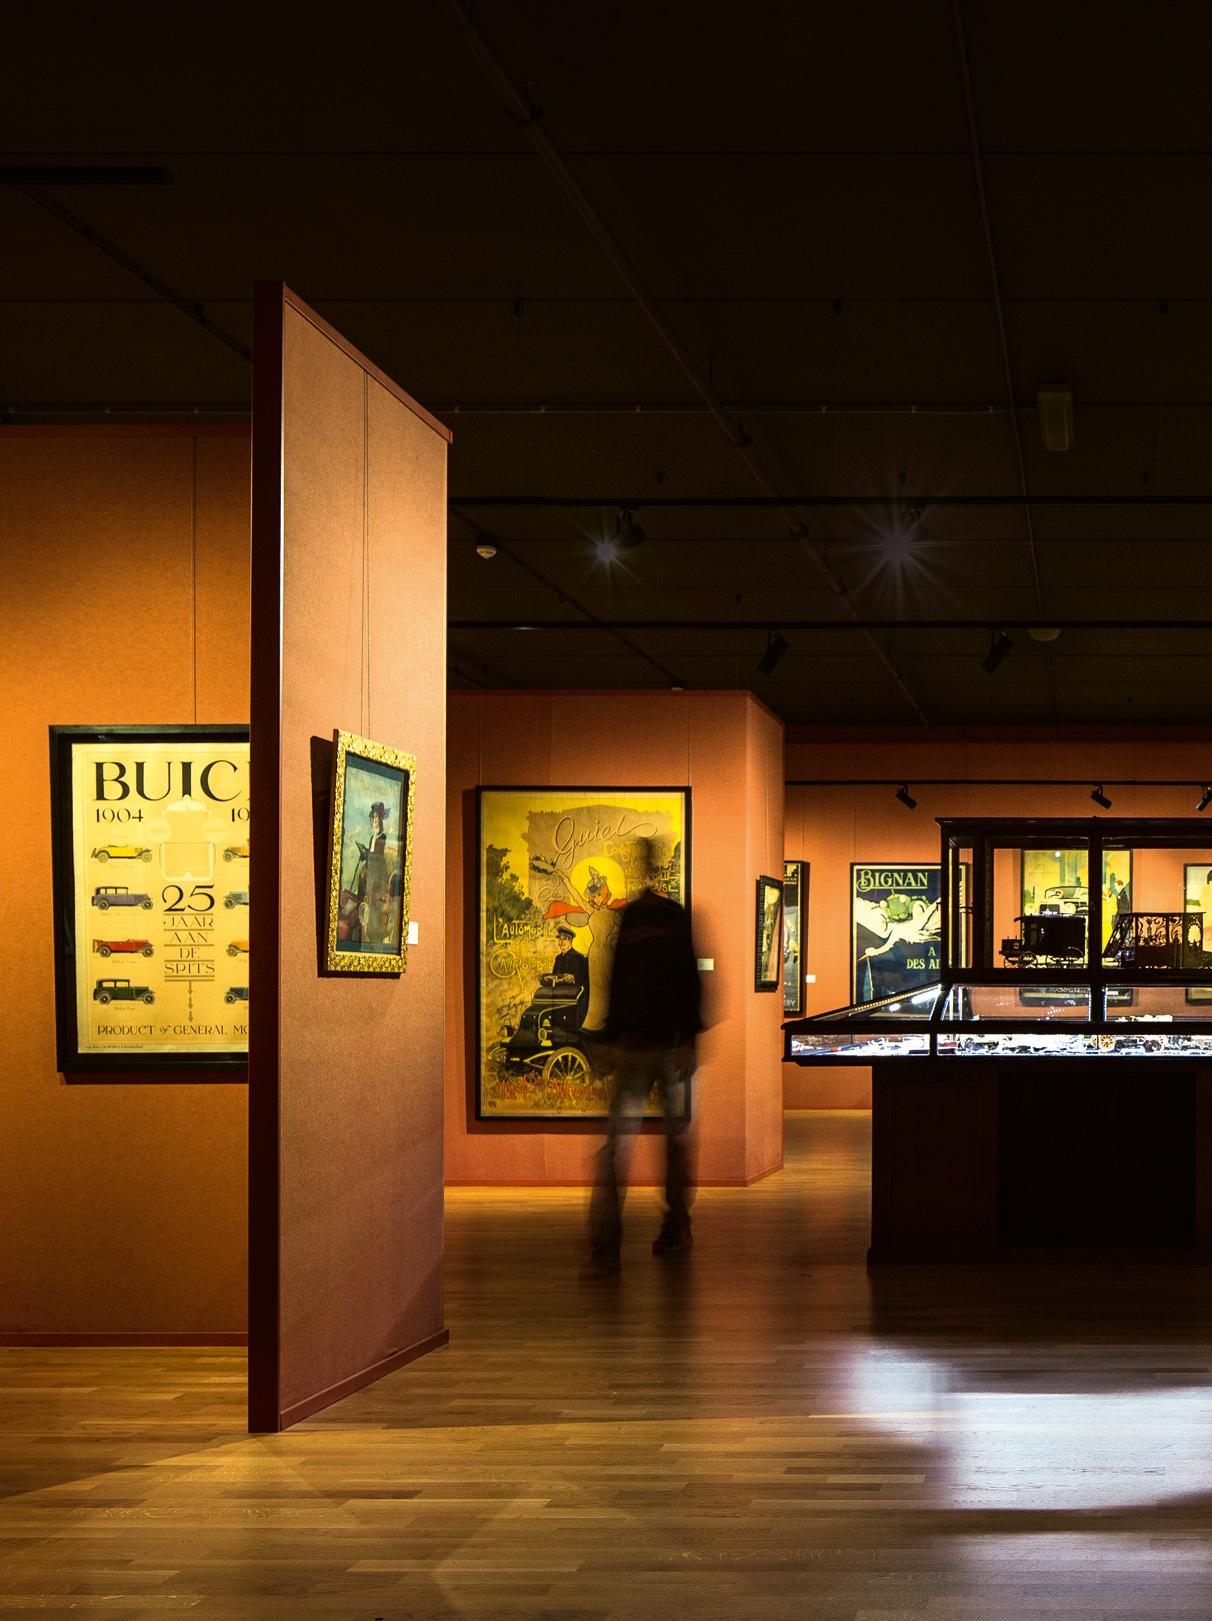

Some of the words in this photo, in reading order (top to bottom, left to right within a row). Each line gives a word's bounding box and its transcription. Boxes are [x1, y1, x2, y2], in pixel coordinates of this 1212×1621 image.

[93, 760, 250, 802] BUIC
[96, 808, 144, 823] 1904
[857, 869, 928, 892] BIGNAN
[162, 885, 215, 912] 25
[163, 916, 214, 928] JAAR
[168, 931, 208, 944] AAN
[179, 947, 200, 959] DE
[164, 962, 215, 975] SPITS
[906, 958, 926, 970] DES
[97, 1024, 154, 1036] PRODUCT
[173, 1024, 228, 1036] GENERAL
